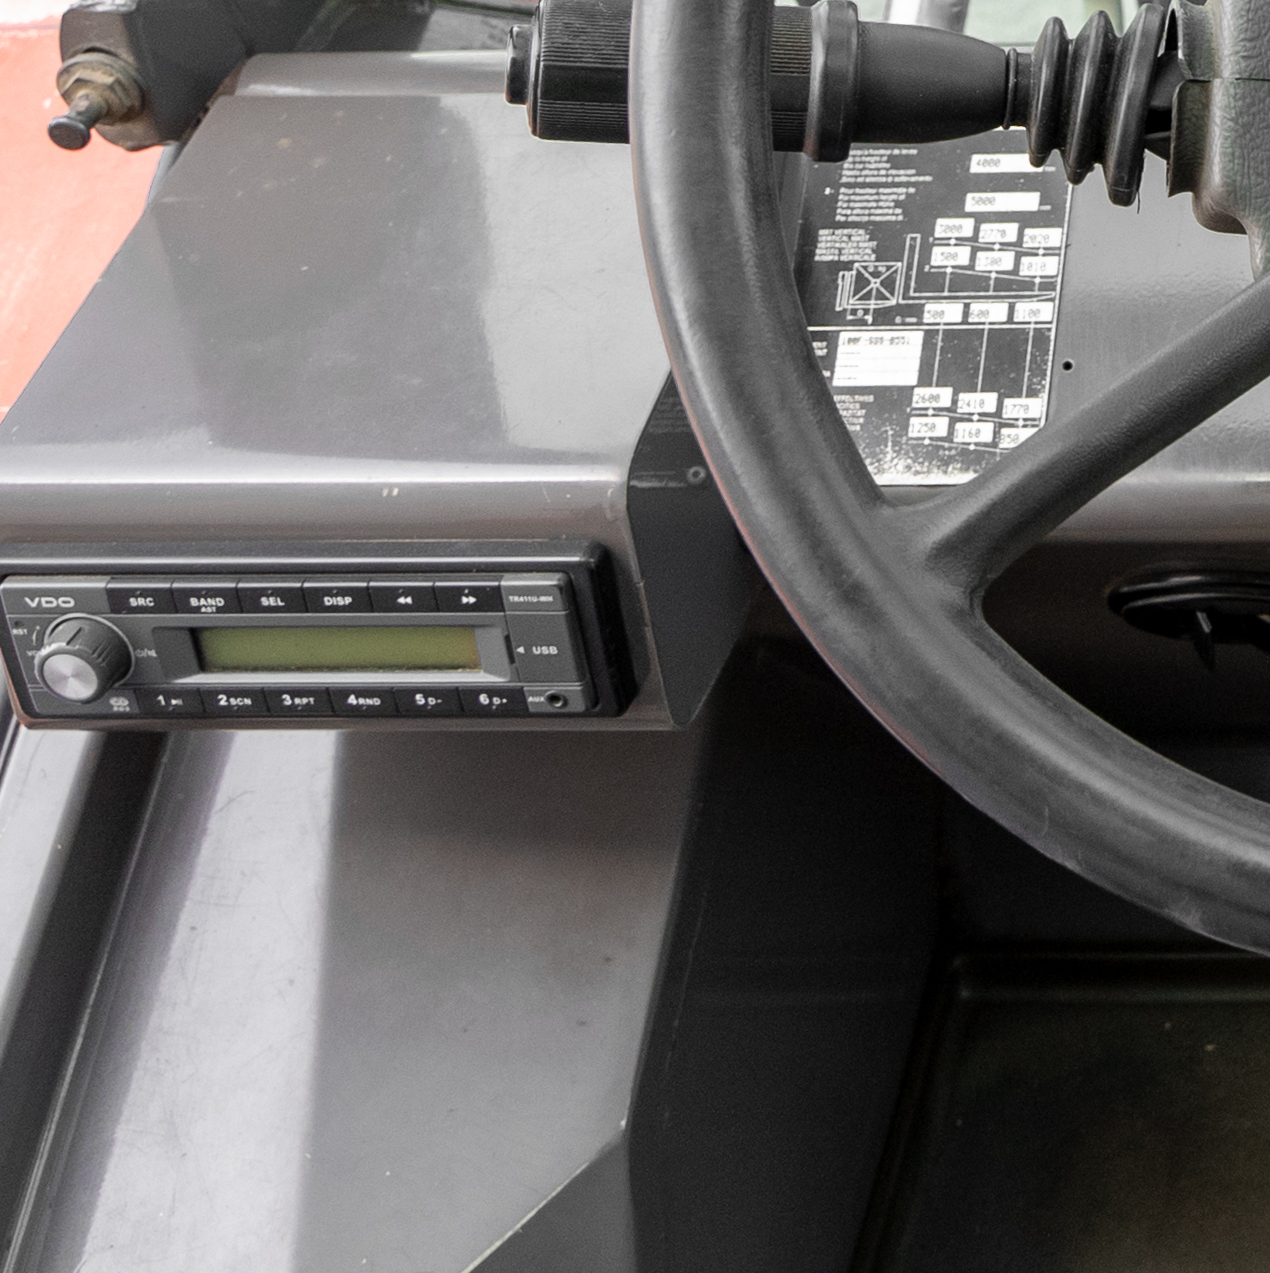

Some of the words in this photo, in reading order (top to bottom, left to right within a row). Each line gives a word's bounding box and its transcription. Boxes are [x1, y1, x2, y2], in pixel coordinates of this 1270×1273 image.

[976, 159, 1001, 168] 4000
[971, 197, 996, 206] 5000
[979, 229, 1007, 239] 2770
[1023, 234, 1050, 243] 2020
[969, 309, 990, 319] 600
[914, 393, 941, 405] 2600
[957, 398, 985, 410] 2410
[1003, 404, 1030, 415] 1770
[909, 423, 937, 434] 1250
[24, 597, 75, 608] VDO
[129, 597, 155, 607] SRC
[190, 597, 225, 608] BAND
[261, 596, 285, 607] SEL
[324, 595, 353, 606] DISP
[532, 645, 558, 656] USB
[157, 694, 166, 706] 1
[528, 696, 545, 704] AUX
